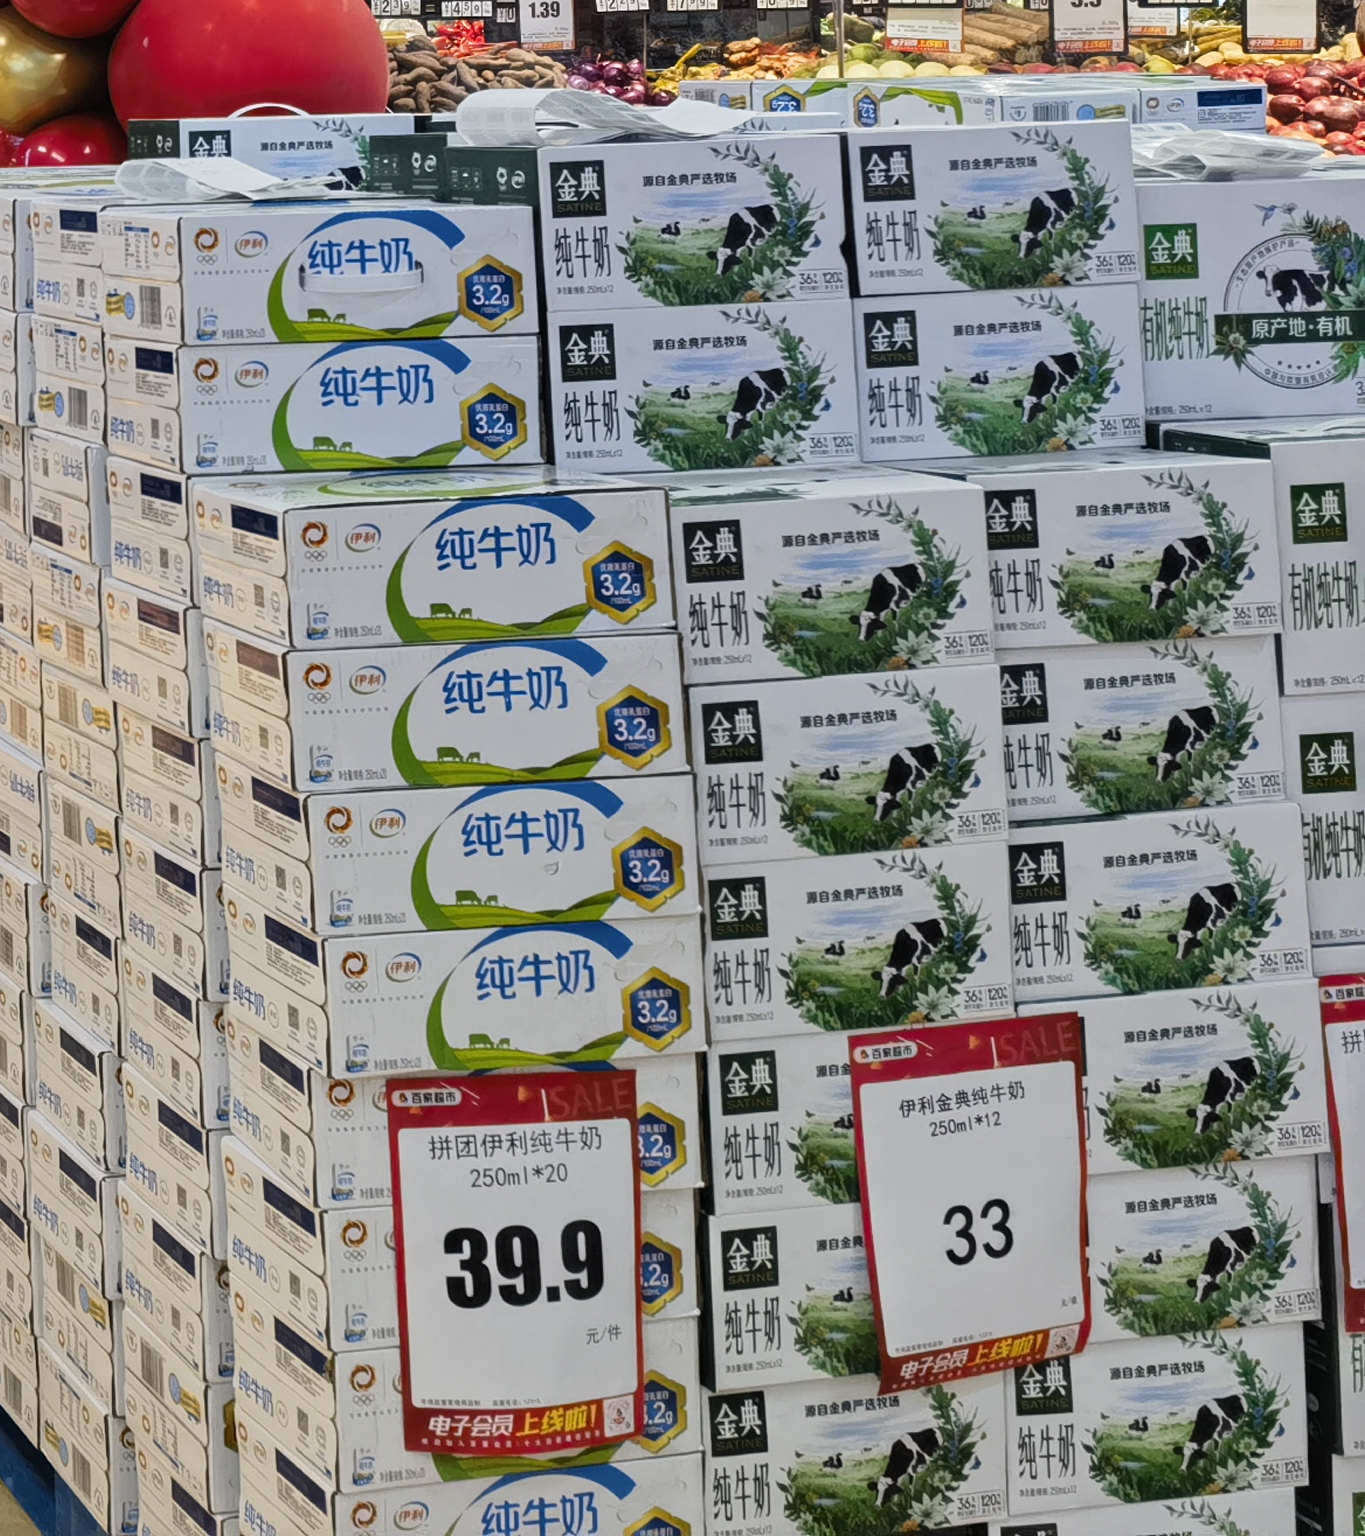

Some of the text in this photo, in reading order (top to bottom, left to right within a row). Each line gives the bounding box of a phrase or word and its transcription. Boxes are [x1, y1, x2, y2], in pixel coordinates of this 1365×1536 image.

[528, 1, 561, 19] 1.39
[260, 140, 334, 152] 源自金典严选牧场
[643, 172, 737, 187] 源自金典严选牧场
[865, 151, 910, 186] 金典
[948, 157, 1038, 171] 源自金典严选牧场
[555, 167, 601, 202] 金典
[237, 236, 266, 253] 伊利
[555, 226, 611, 278] 纯牛奶
[866, 210, 921, 262] 纯牛奶
[1148, 230, 1194, 264] 金典
[308, 237, 414, 275] 纯牛奶
[472, 285, 509, 307] 3.2g
[653, 335, 748, 350] 源自金典严选牧场
[869, 317, 913, 351] 金典
[1140, 296, 1210, 361] 有机纯牛奶
[1251, 316, 1353, 339] 原产地·有机
[565, 330, 611, 365] 金典
[237, 366, 266, 383] 伊利
[320, 365, 435, 407] 纯牛奶
[564, 390, 621, 443] 纯牛奶
[868, 375, 922, 428] 纯牛奶
[476, 414, 513, 436] 3.2g
[987, 496, 1033, 532] 金典
[1075, 502, 1170, 517] 源自金典严选牧场
[1296, 490, 1342, 527] 金典
[349, 530, 377, 546] 伊利
[435, 524, 557, 572] 纯牛奶
[689, 527, 738, 565] 金典
[782, 530, 880, 548] 源自金典严选牧场
[600, 572, 641, 597] 3.2g
[990, 558, 1044, 614] 纯牛奶
[1289, 561, 1360, 631] 有机纯牛奶
[689, 591, 750, 648] 纯牛奶
[354, 671, 383, 689] 伊利
[443, 667, 569, 715] 纯牛奶
[1083, 673, 1176, 690] 源自金典严选牧场
[613, 717, 656, 742] 3.2g
[708, 708, 756, 747] 金典
[1305, 739, 1350, 777] 金典
[707, 772, 767, 830] 纯牛奶
[375, 817, 401, 830] 伊利
[461, 809, 584, 857] 纯牛奶
[628, 860, 669, 883] 3.2g
[1014, 849, 1061, 887] 金典
[1103, 850, 1198, 868] 源自金典严选牧场
[714, 884, 762, 923] 金典
[806, 885, 904, 904] 源自金典严选牧场
[1014, 912, 1071, 968] 纯牛奶
[390, 962, 416, 975] 伊利
[475, 950, 596, 1000] 纯牛奶
[713, 948, 771, 1006] 纯牛奶
[637, 1000, 677, 1024] 3.2g
[1000, 1022, 1077, 1062] SALE
[1124, 1024, 1218, 1044] 源自金典严选牧场
[871, 1045, 913, 1059] 百家超市
[724, 1058, 773, 1097] 金典
[411, 1092, 457, 1104] 百家超市
[550, 1077, 633, 1119] SALE
[899, 1081, 1026, 1119] 伊利金典纯牛奶
[429, 1127, 602, 1160] 拼团伊利纯牛奶
[724, 1121, 781, 1180] 纯牛奶
[1125, 1193, 1218, 1214] 源自金典严选牧场
[944, 1199, 1014, 1265] 33
[443, 1220, 604, 1309] 39.9
[726, 1233, 774, 1275] 金典
[586, 1325, 622, 1344] 元/件
[725, 1296, 781, 1355] 纯牛奶
[900, 1349, 968, 1379] 电子会员
[1020, 1363, 1069, 1400] 金典
[1109, 1361, 1206, 1381] 源自金典严选牧场
[428, 1404, 596, 1438] 电子会员 上线啦!
[715, 1402, 764, 1439] 金典
[804, 1395, 901, 1417] 源自金典严选牧场
[1018, 1422, 1076, 1481] 纯牛奶
[713, 1465, 771, 1522] 纯牛奶
[399, 1508, 424, 1524] 伊利
[481, 1492, 598, 1536] 纯牛奶
